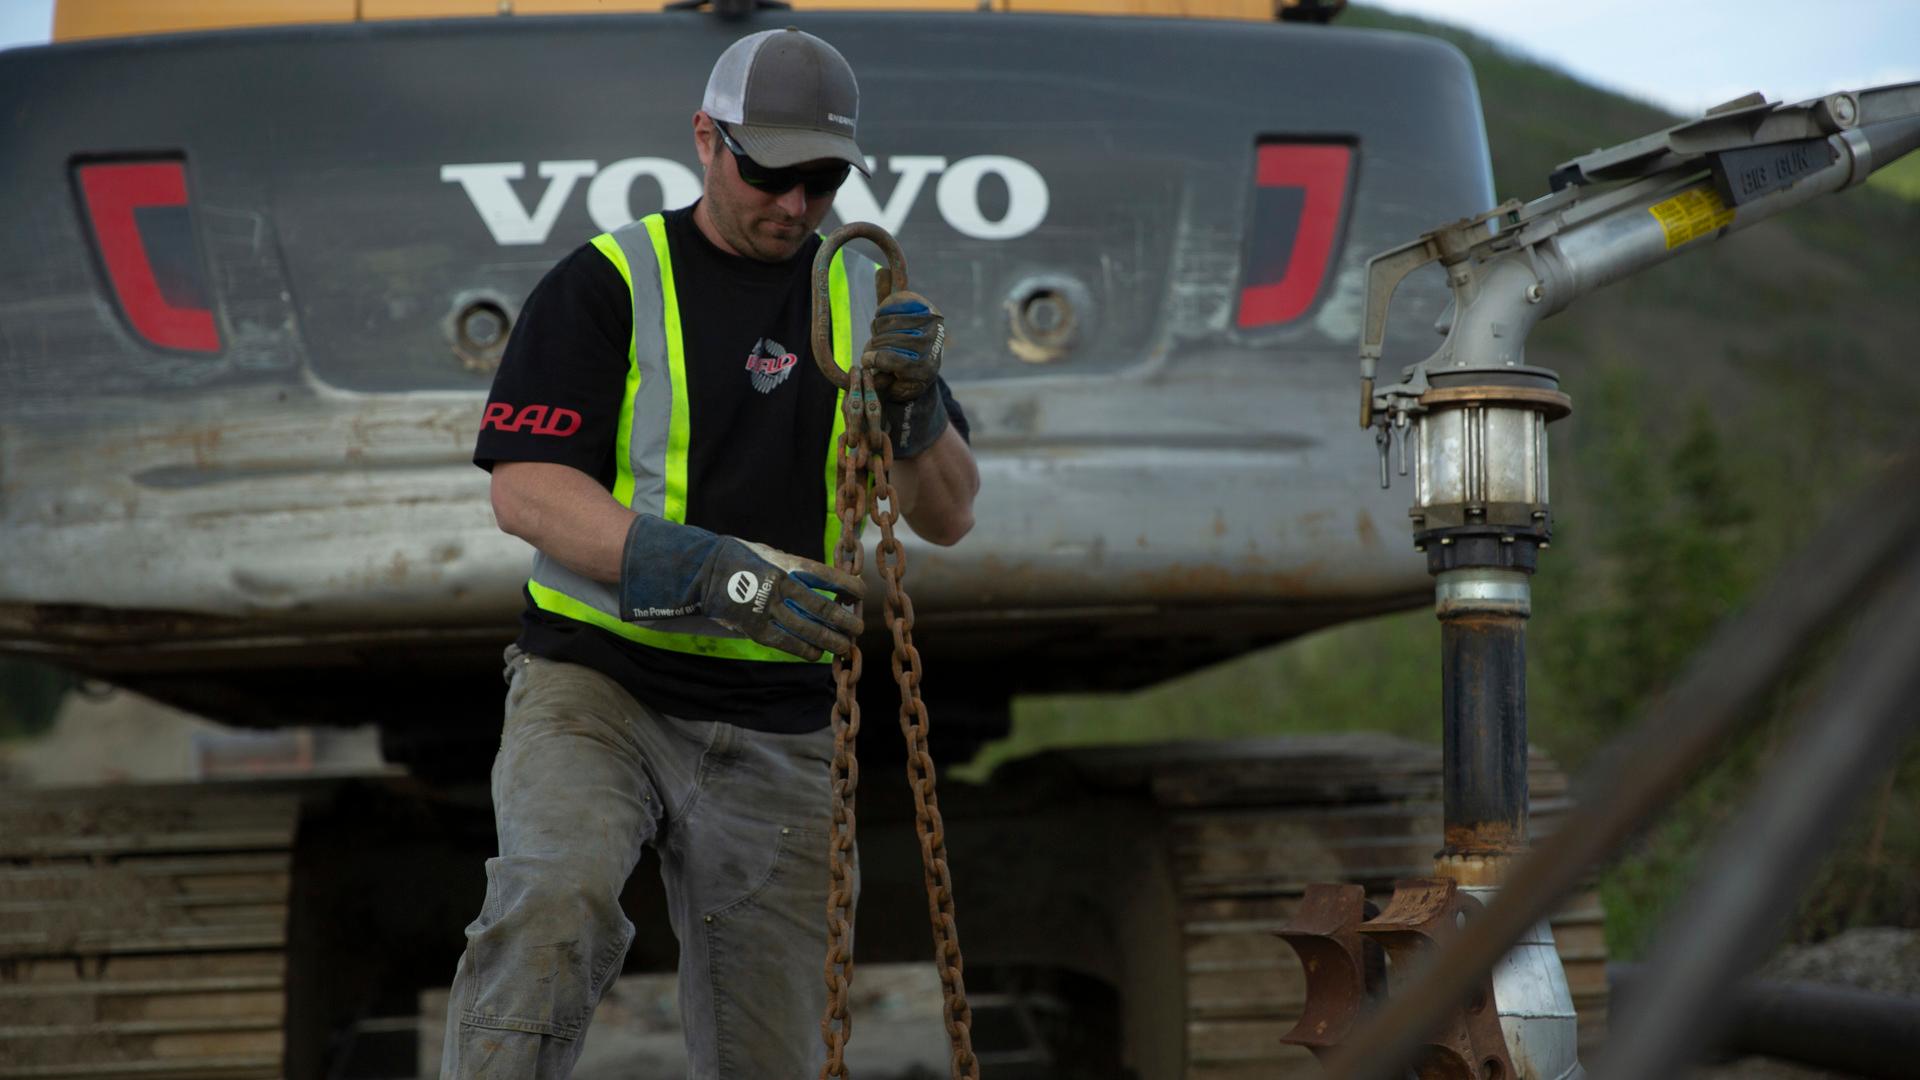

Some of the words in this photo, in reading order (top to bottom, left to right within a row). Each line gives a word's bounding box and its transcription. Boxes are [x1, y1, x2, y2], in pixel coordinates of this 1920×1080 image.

[440, 153, 1049, 245] VOVO
[480, 402, 582, 437] RAD
[633, 607, 648, 617] The
[649, 606, 674, 617] Power
[752, 575, 774, 614] Miller
